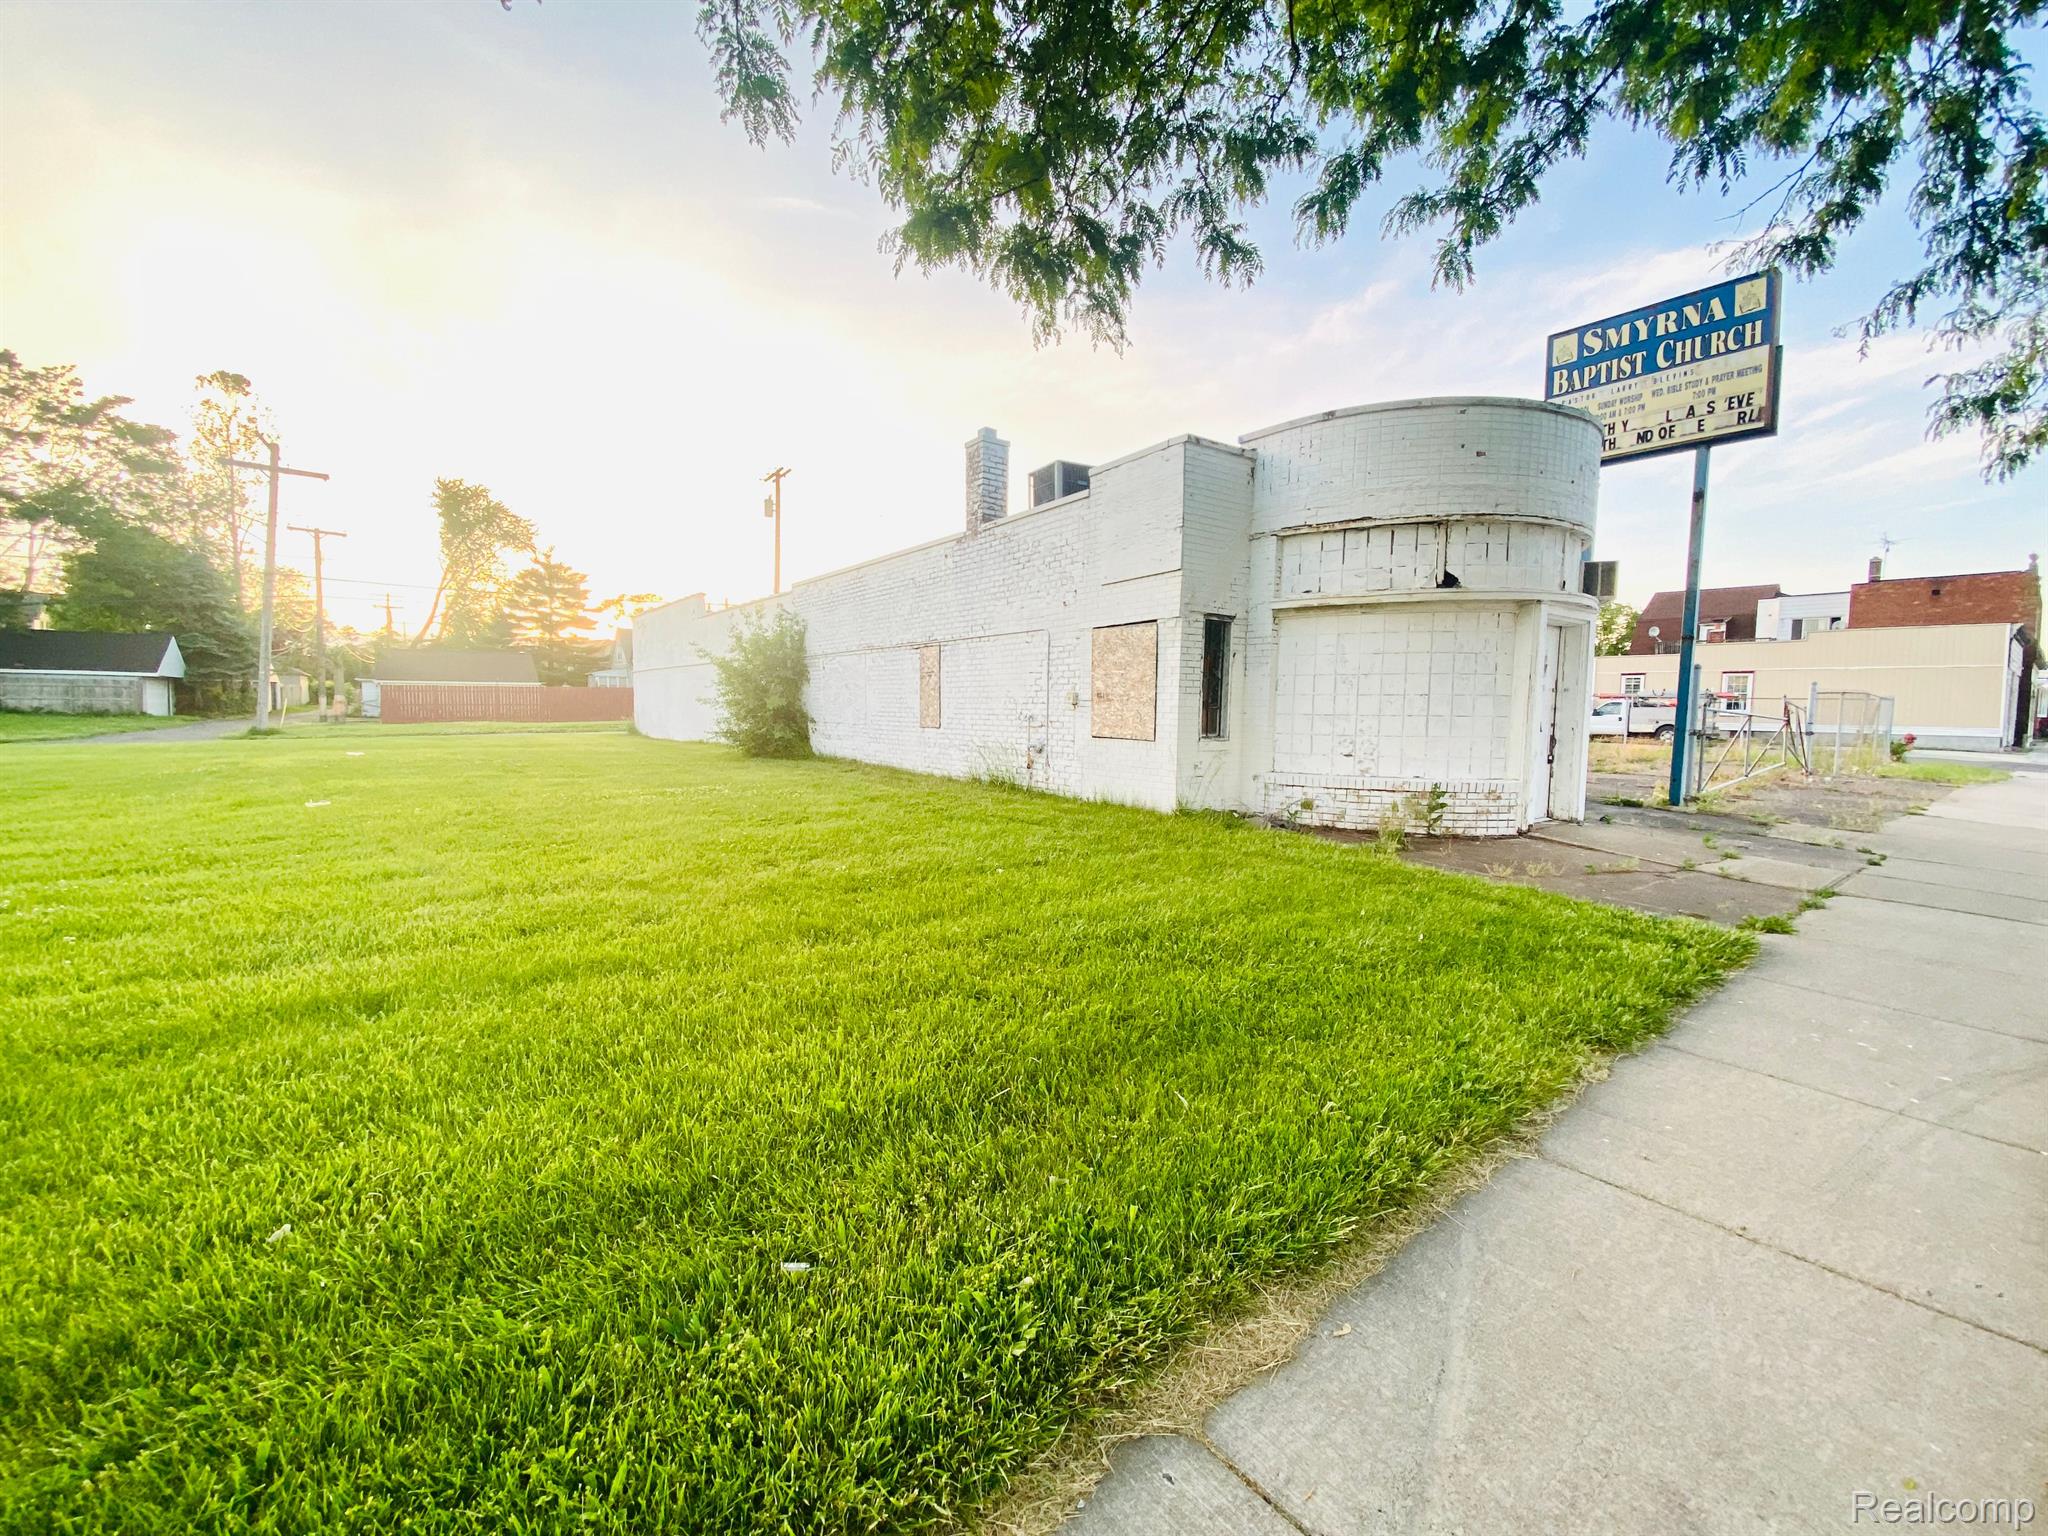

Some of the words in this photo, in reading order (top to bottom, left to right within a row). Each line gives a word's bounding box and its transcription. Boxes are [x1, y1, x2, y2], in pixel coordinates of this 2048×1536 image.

[1583, 297, 1727, 357] SMYRNA
[1552, 350, 1647, 396] BAPTIST
[1656, 319, 1763, 369] CHURCH
[1685, 378, 1703, 390] STUDY
[1711, 371, 1735, 384] PRAYER
[1737, 364, 1763, 377] MEETING
[1707, 387, 1716, 396] PM
[1658, 424, 1676, 440] OF
